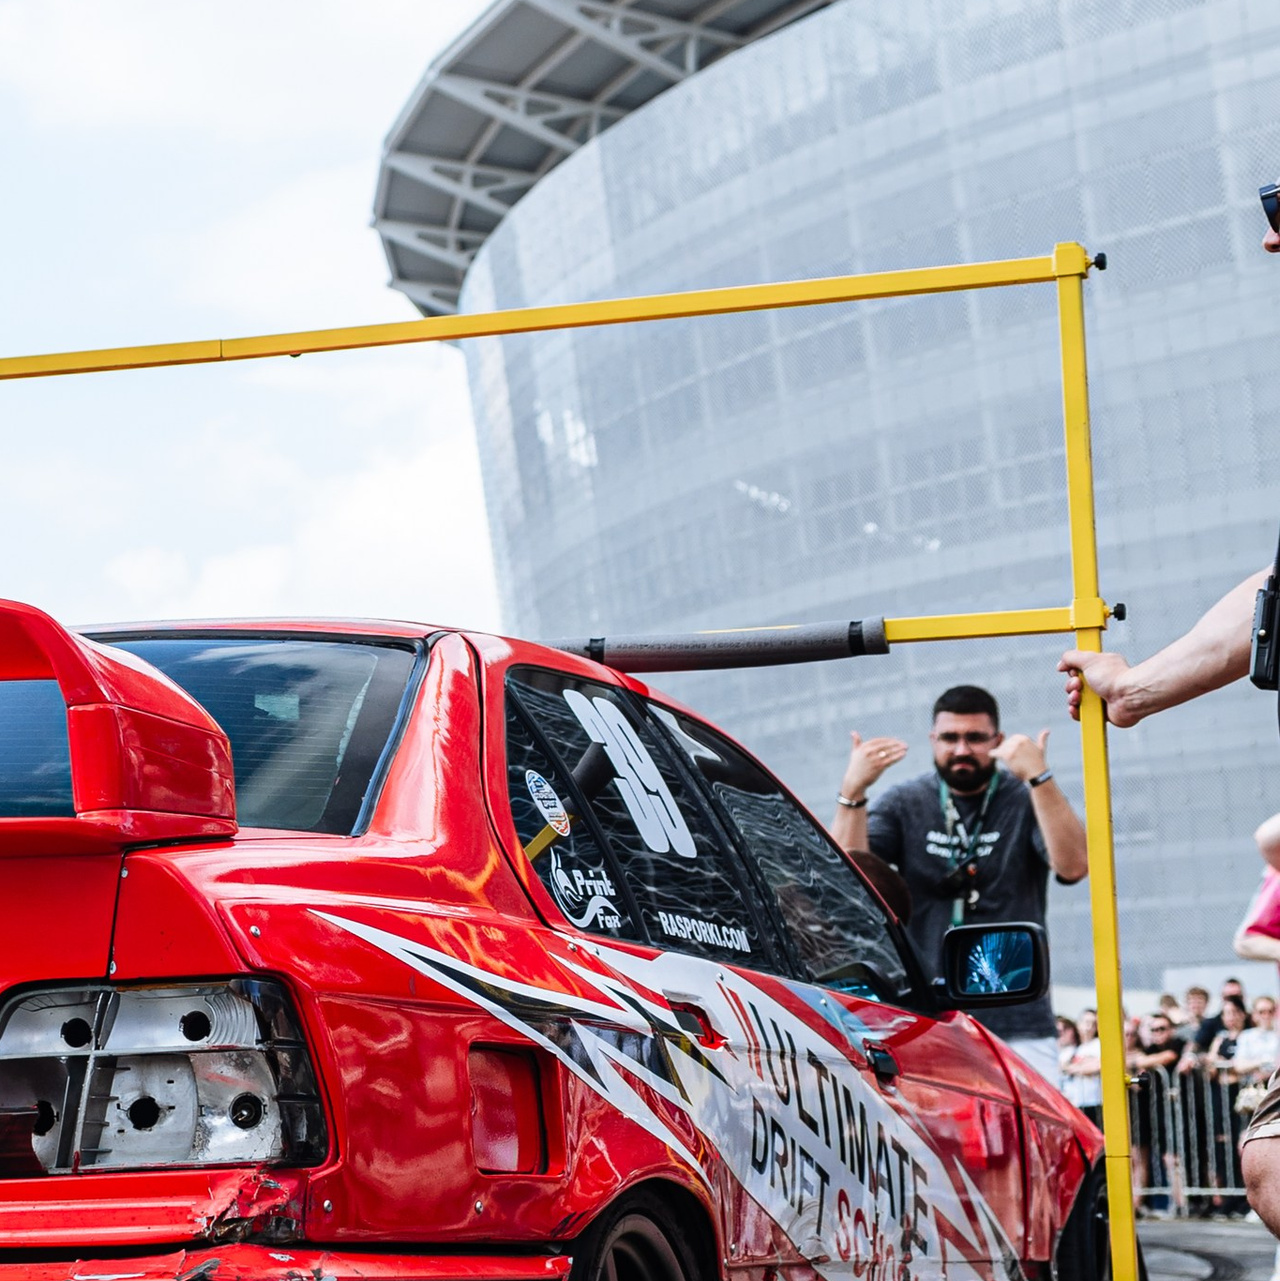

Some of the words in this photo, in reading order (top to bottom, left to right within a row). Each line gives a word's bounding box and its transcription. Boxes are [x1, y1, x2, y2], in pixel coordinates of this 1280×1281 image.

[572, 869, 617, 897] Print
[658, 911, 752, 953] RASPORKI.COM
[751, 1094, 830, 1236] DRIFT
